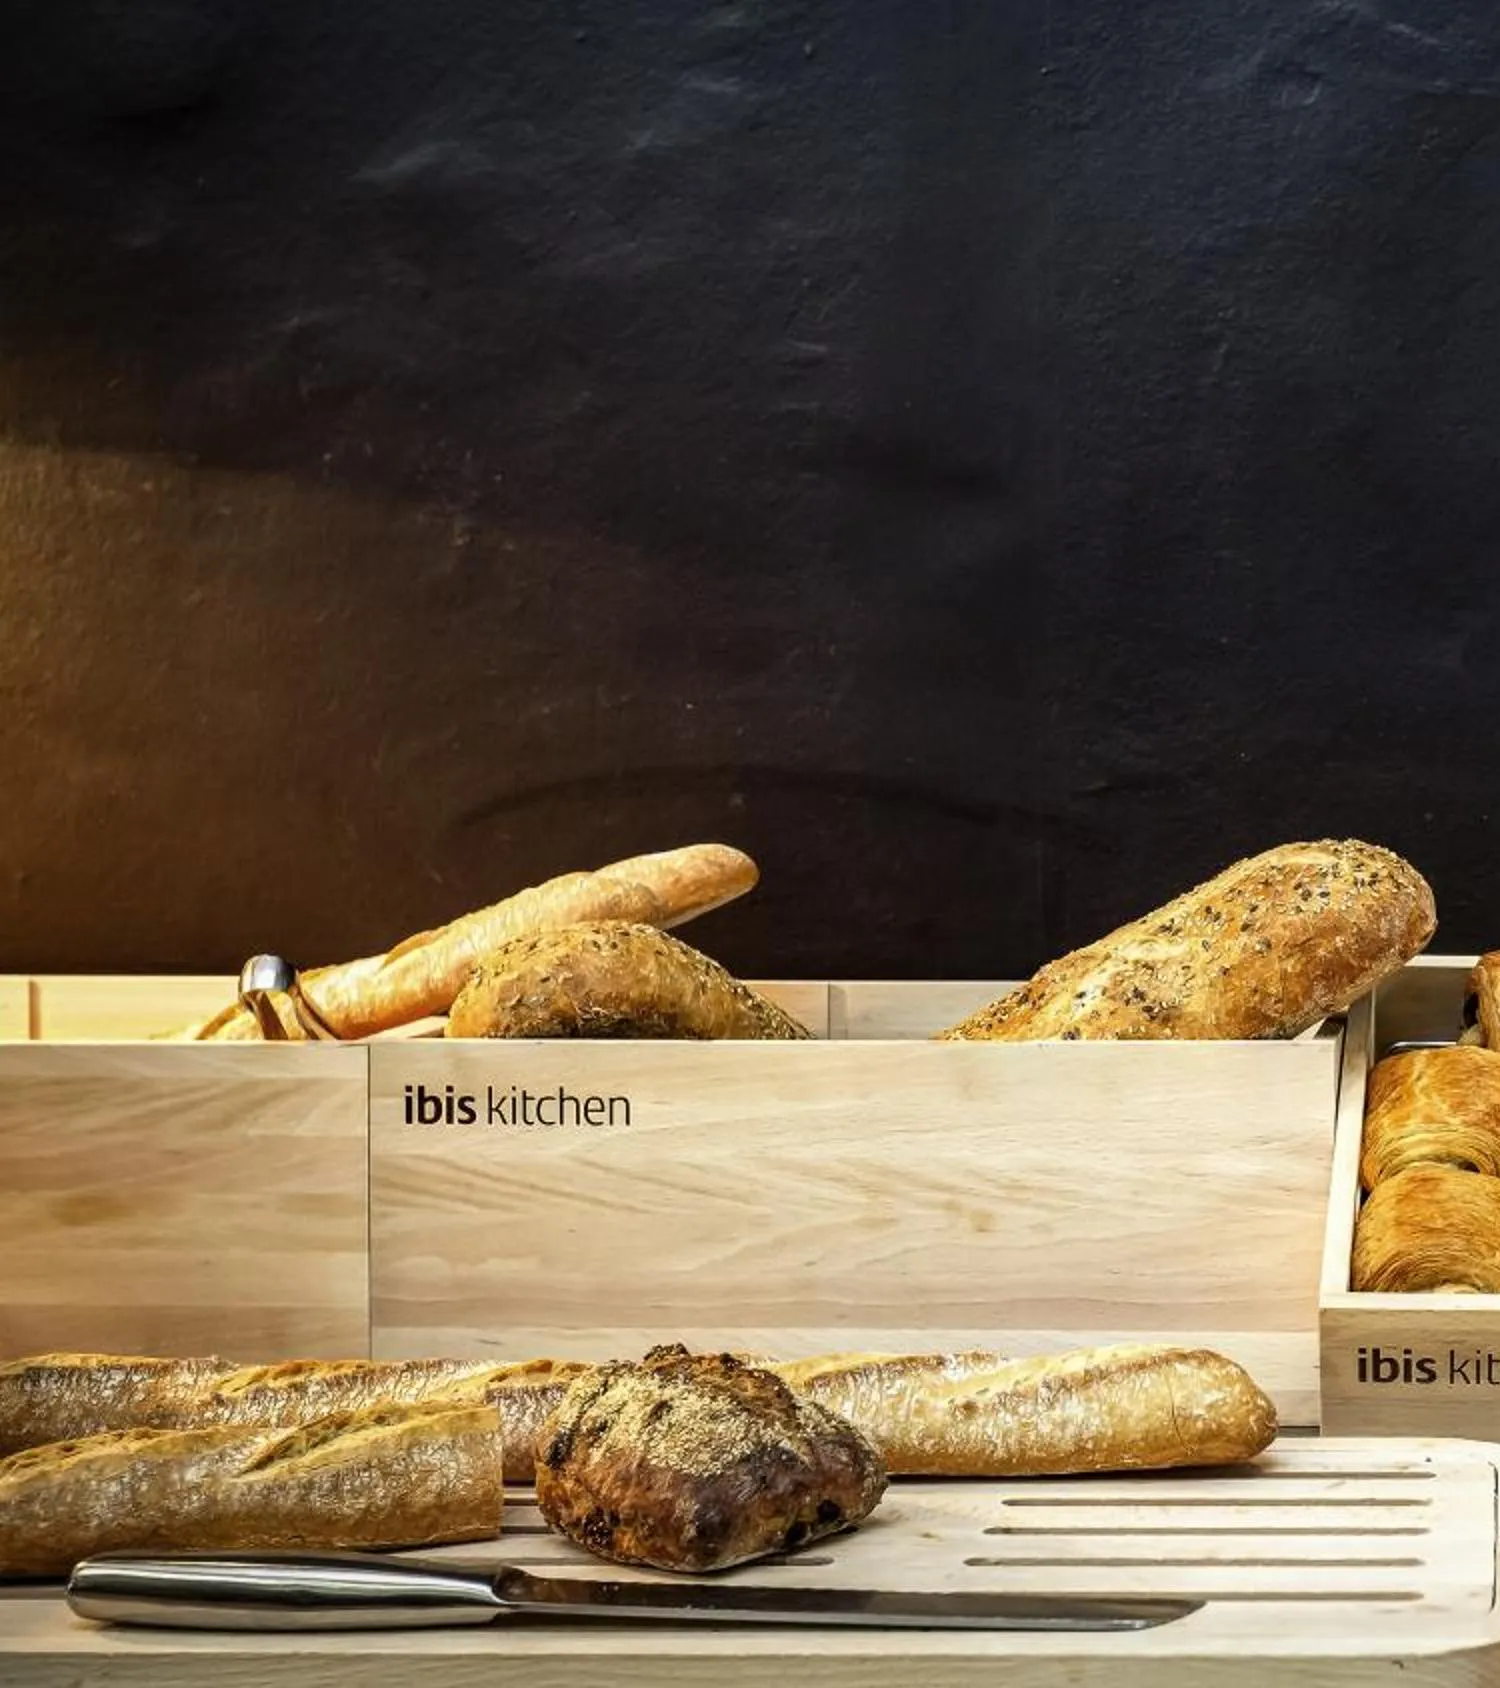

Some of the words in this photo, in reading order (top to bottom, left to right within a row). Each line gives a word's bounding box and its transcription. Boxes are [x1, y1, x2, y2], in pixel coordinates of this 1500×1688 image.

[404, 1085, 477, 1125] ibis
[487, 1085, 631, 1126] kitchen
[1357, 1347, 1438, 1384] ibis
